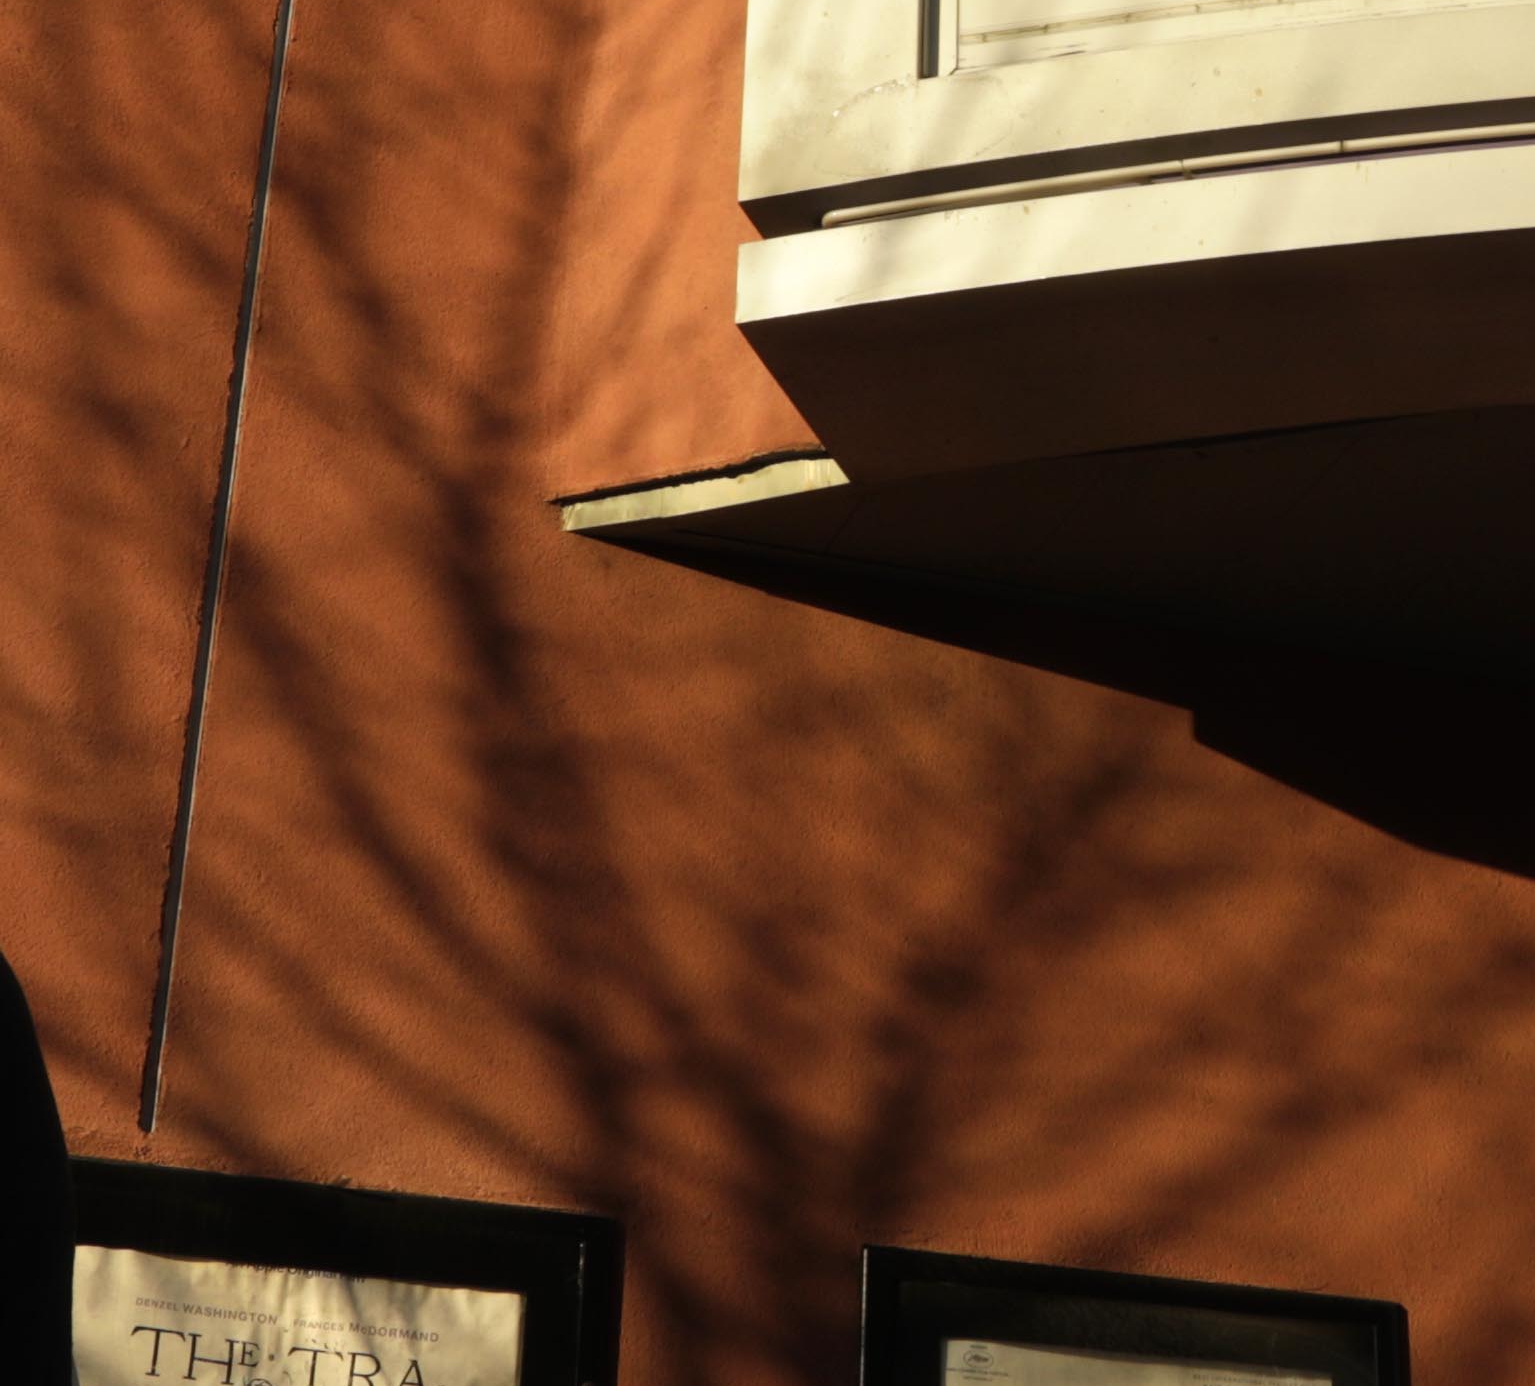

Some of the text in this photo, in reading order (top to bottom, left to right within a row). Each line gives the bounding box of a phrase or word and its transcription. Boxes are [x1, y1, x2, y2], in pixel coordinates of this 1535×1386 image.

[136, 1296, 278, 1325] DENZEL WASHINGTON
[293, 1318, 344, 1332] FRANCES
[130, 1325, 261, 1386] THE
